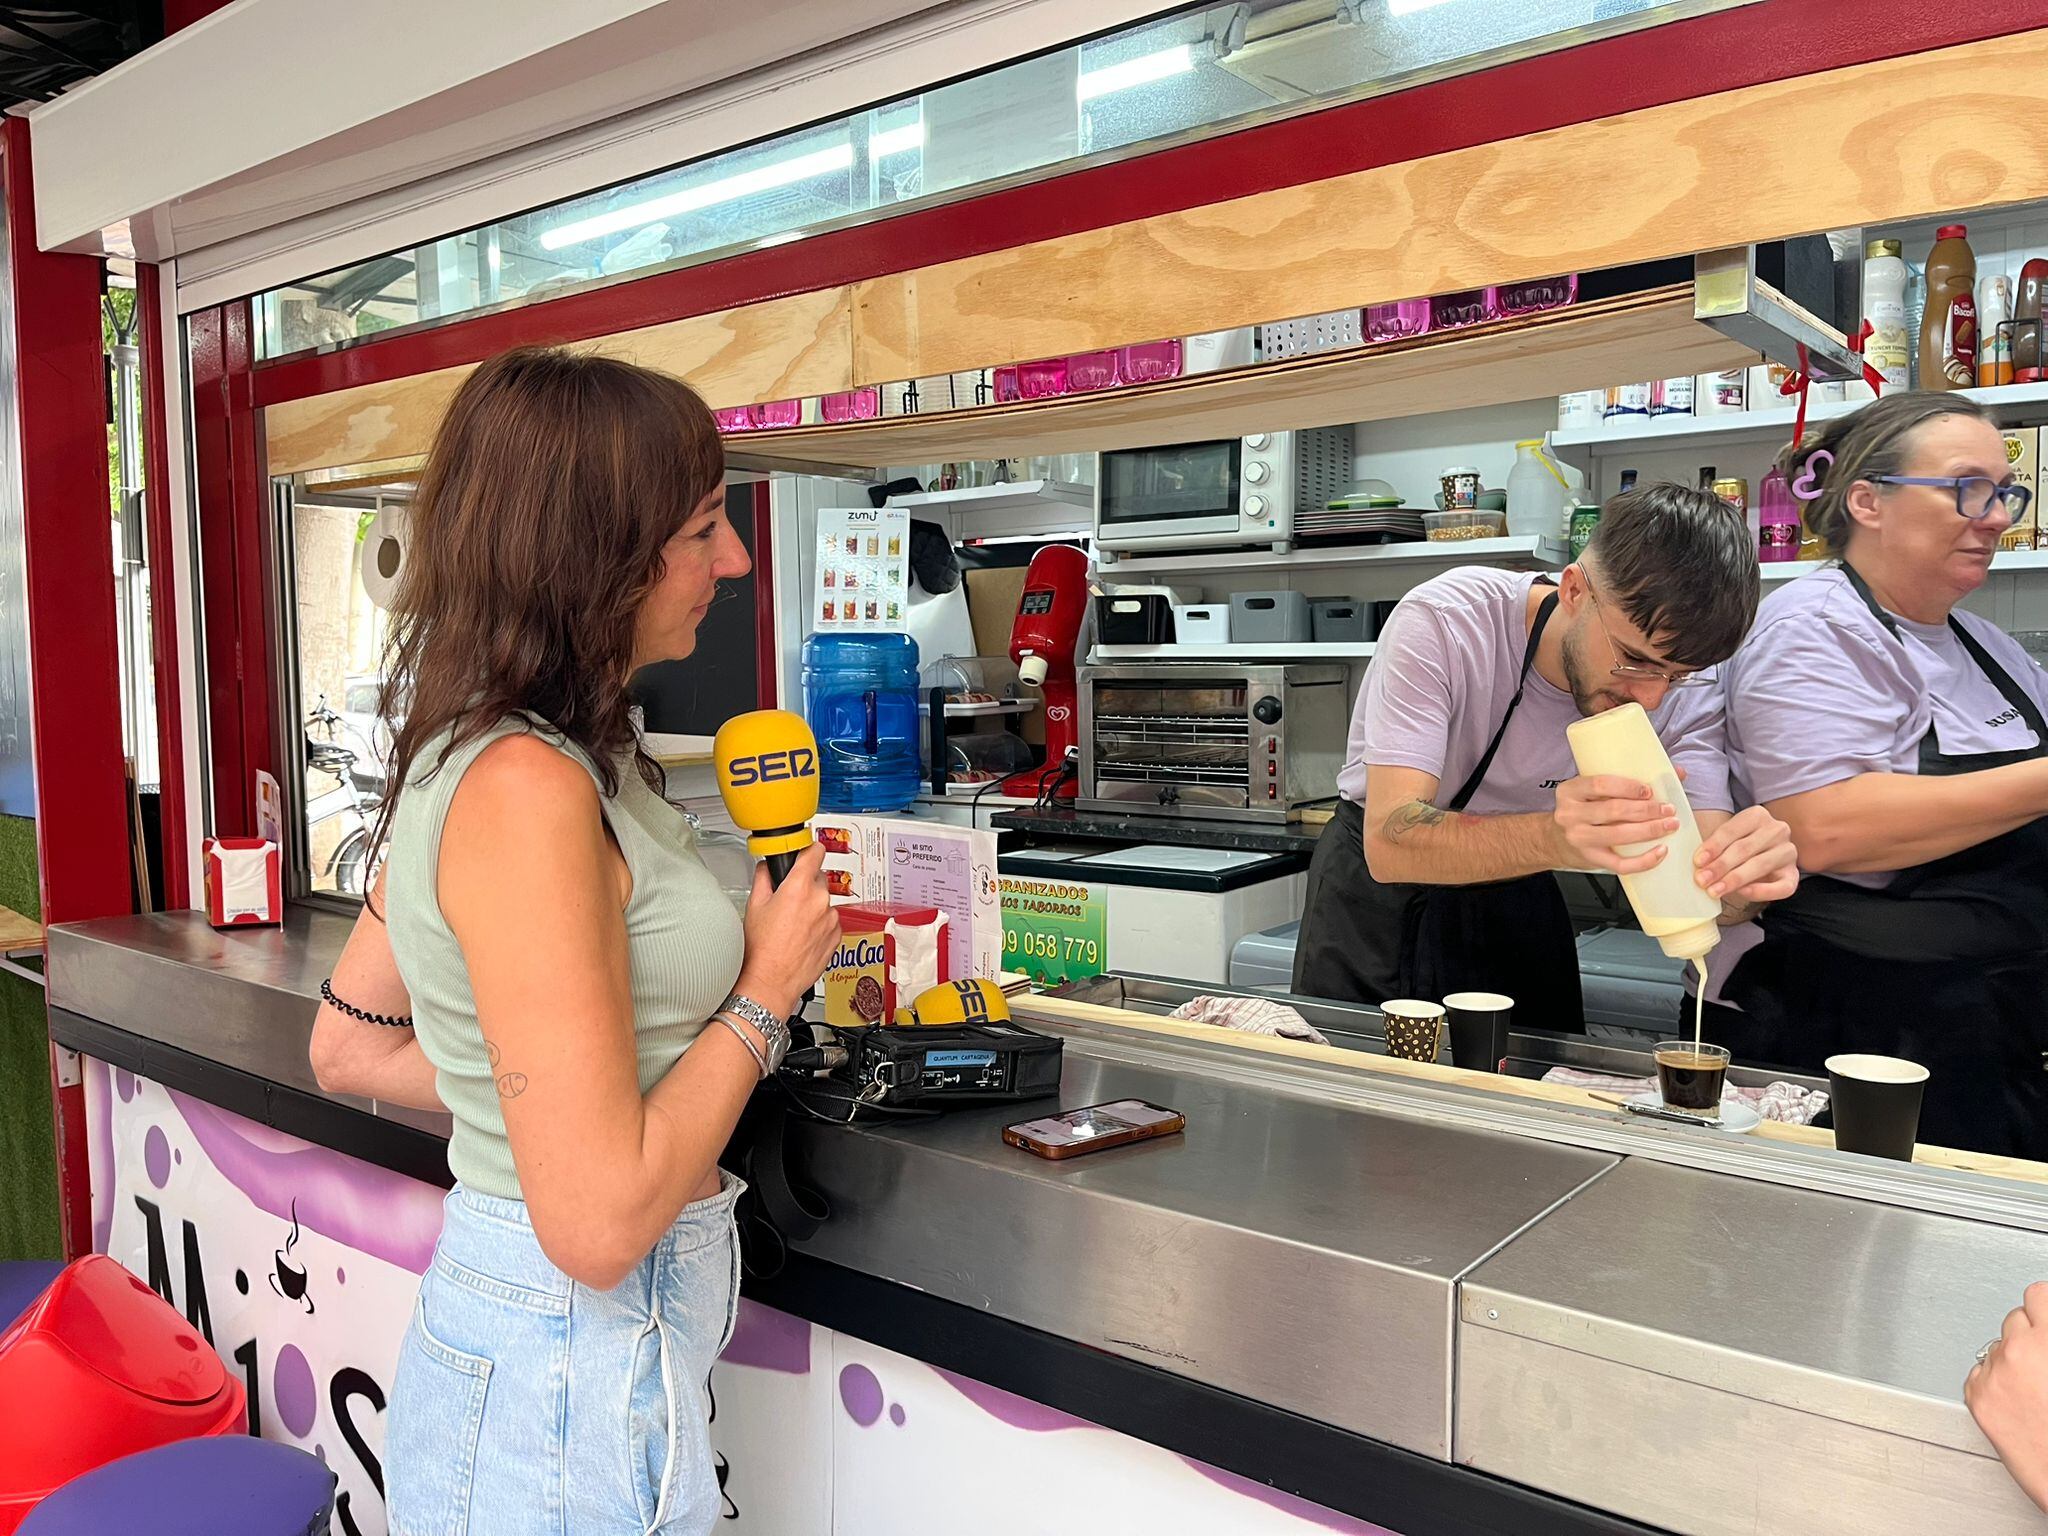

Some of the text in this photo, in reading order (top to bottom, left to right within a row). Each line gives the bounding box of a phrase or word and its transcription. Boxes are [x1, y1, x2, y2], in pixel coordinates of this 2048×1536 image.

[729, 748, 815, 787] SER
[1023, 899, 1082, 916] TABORROS
[1024, 931, 1058, 958] 058
[1063, 936, 1098, 965] 779
